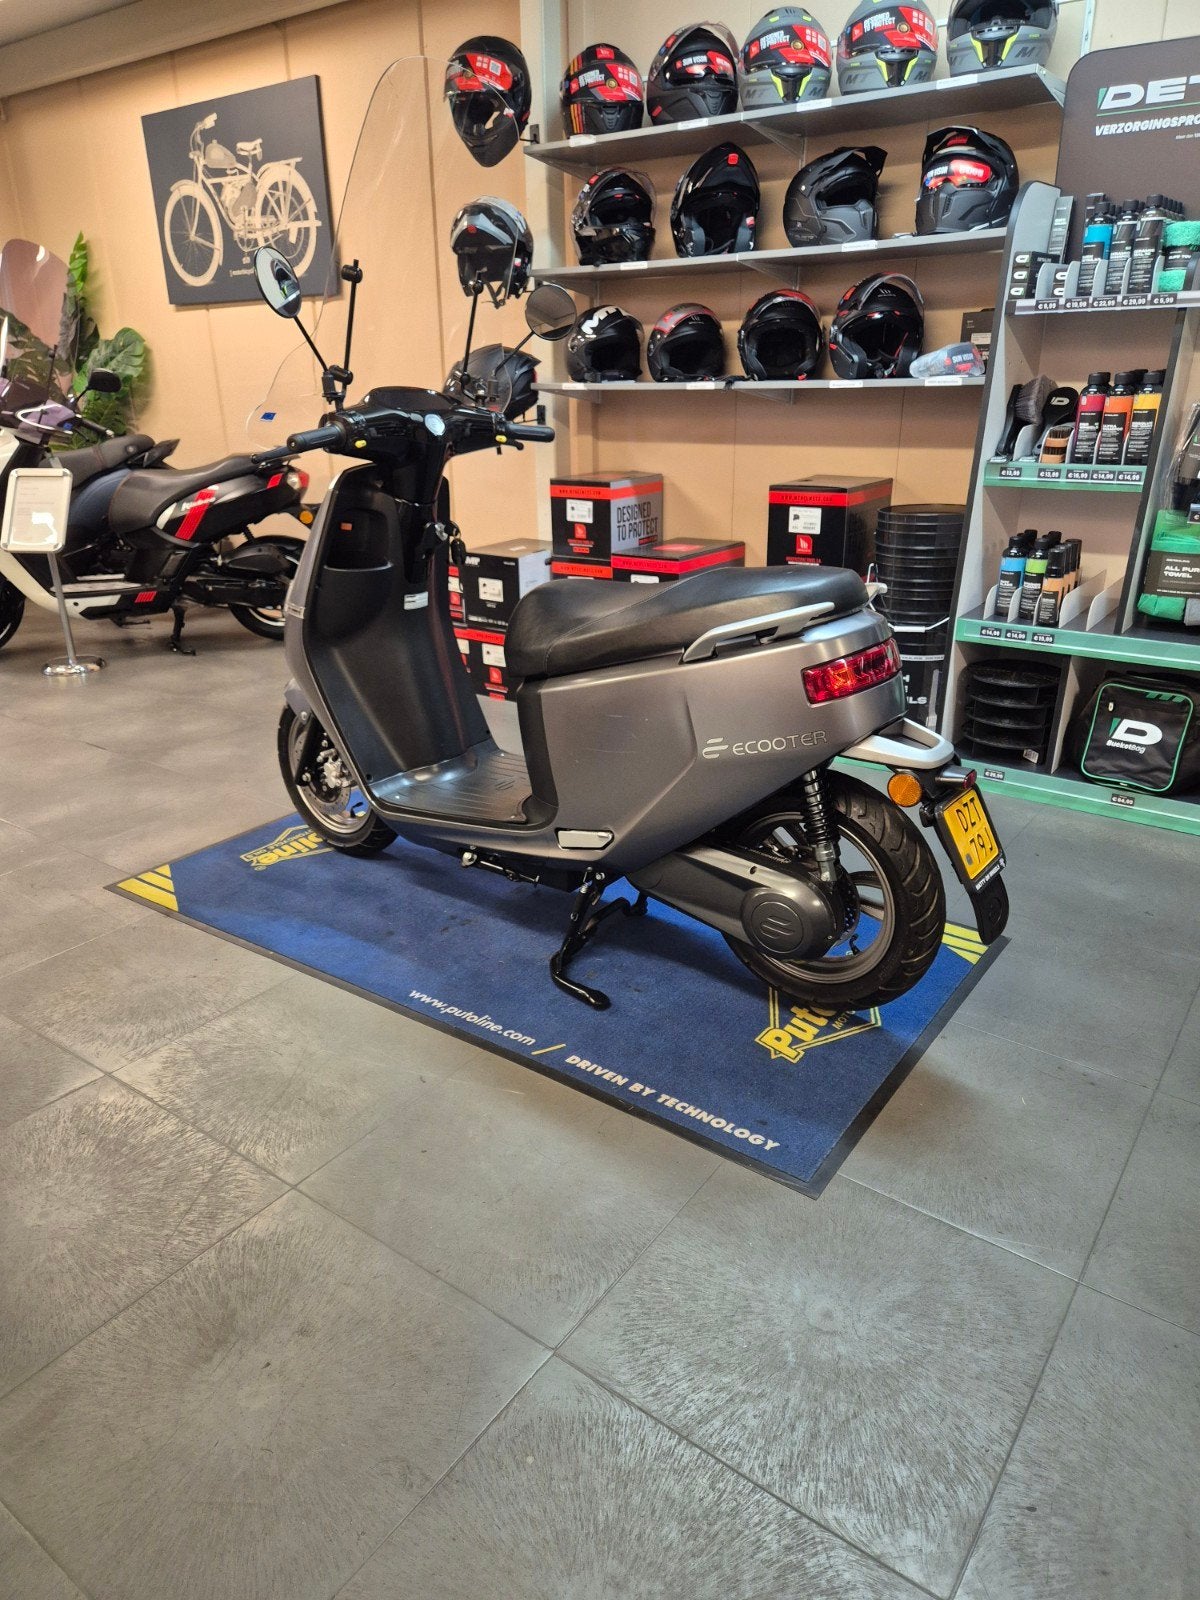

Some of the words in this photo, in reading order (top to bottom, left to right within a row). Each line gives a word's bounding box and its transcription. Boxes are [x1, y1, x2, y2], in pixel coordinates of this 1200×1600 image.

[616, 501, 652, 524] DESIGNED
[616, 524, 627, 542] TO
[628, 517, 659, 539] PROTECT
[1163, 571, 1193, 579] TOWEL
[732, 730, 827, 756] ECOOTER
[1106, 739, 1147, 755] BucketBag
[955, 796, 982, 833] DZT
[408, 989, 537, 1046] www.putoline.com
[564, 1055, 630, 1087] DRIVEN
[628, 1082, 657, 1098] BY
[656, 1093, 781, 1152] TECHNOLOGY
